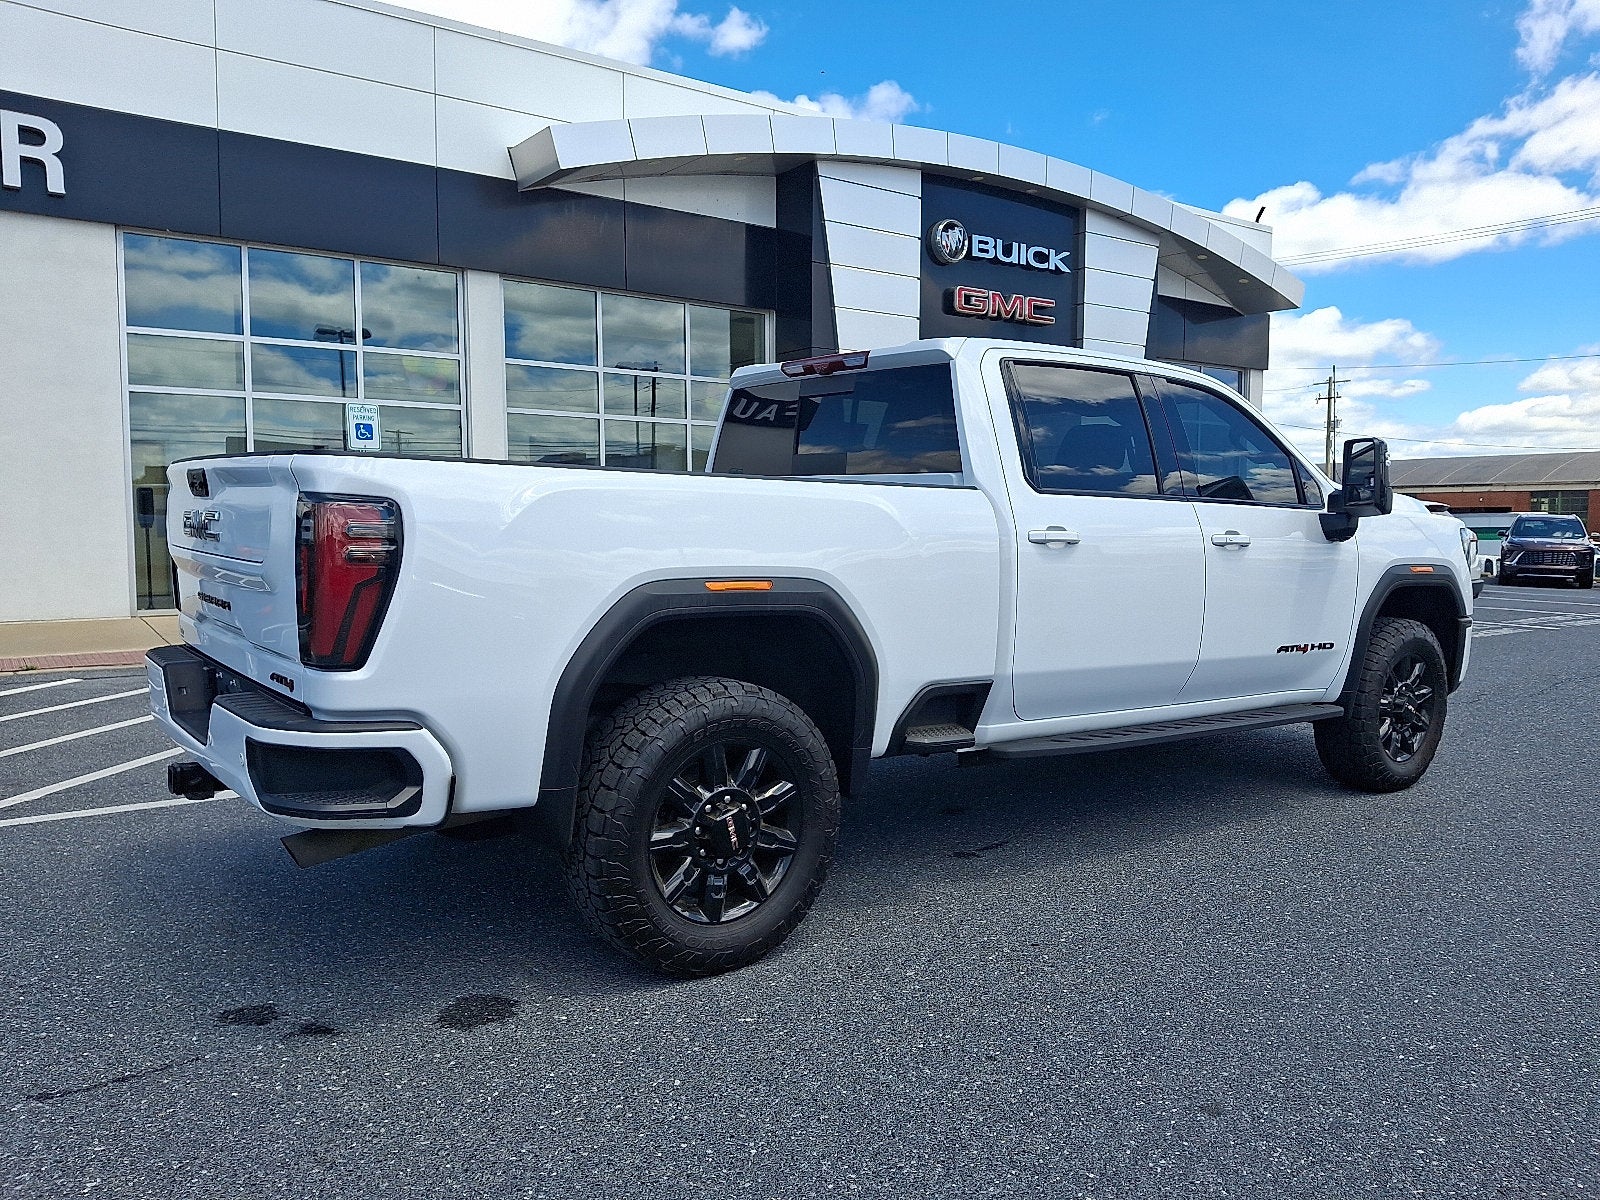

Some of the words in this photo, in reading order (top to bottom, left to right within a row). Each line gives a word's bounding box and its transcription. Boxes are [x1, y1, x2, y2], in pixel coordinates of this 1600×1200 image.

[971, 233, 1071, 273] BUICK
[954, 285, 1056, 324] GMC
[349, 405, 377, 414] RESERVED
[352, 414, 375, 422] PARKING
[183, 509, 221, 543] GMC
[1276, 643, 1309, 655] AT4
[1310, 642, 1335, 651] HD
[269, 672, 295, 693] AT4
[725, 815, 739, 851] GMC
